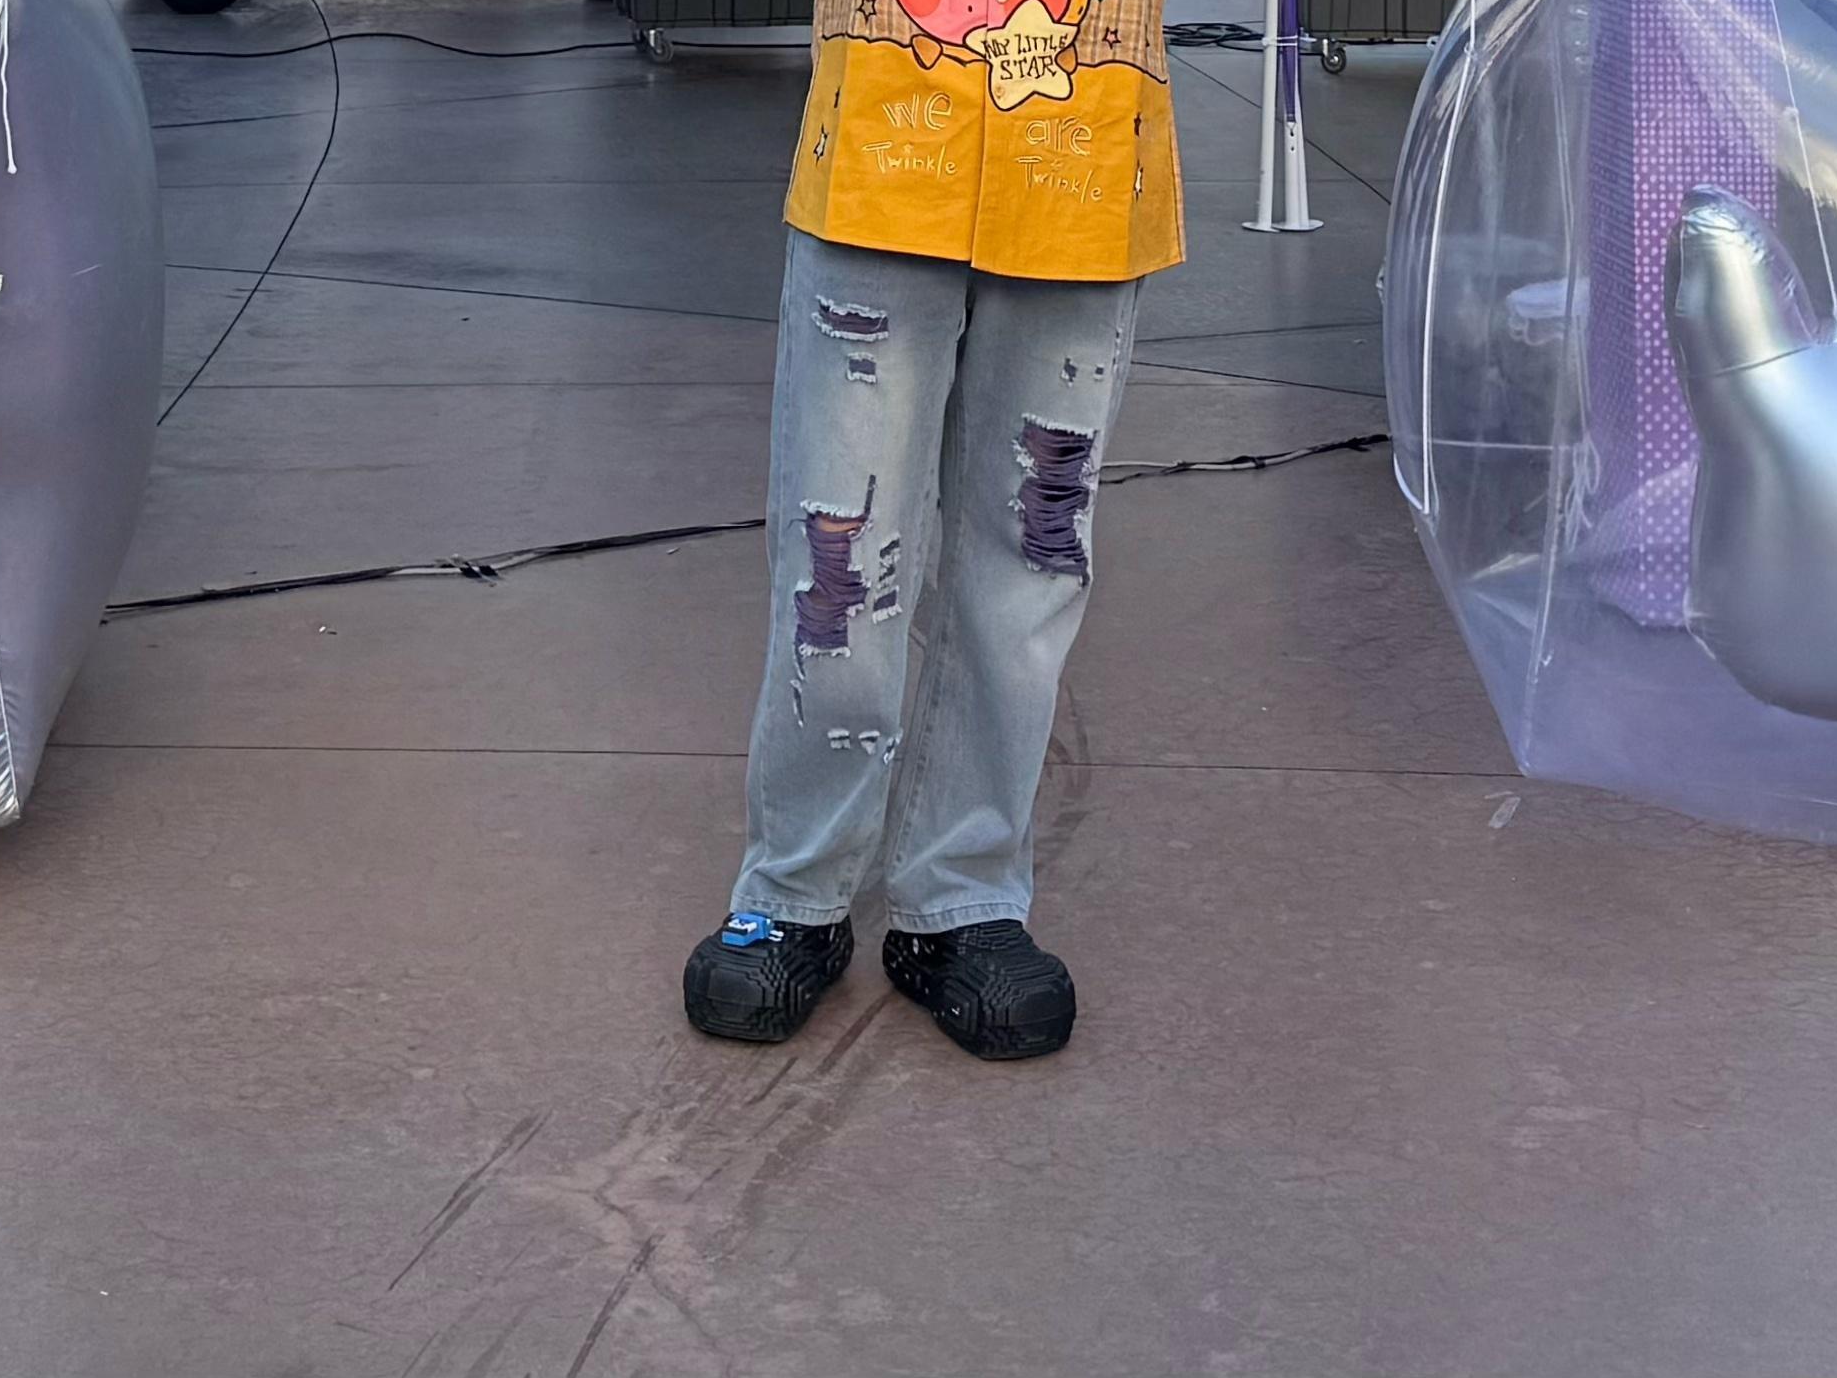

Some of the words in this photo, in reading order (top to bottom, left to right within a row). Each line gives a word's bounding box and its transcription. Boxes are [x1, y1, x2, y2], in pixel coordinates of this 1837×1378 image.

[981, 37, 1010, 59] MY
[1000, 55, 1057, 81] STAR
[882, 92, 953, 130] we
[1026, 116, 1092, 155] are
[862, 141, 958, 179] Twinkle
[1016, 155, 1103, 203] Twinkle
